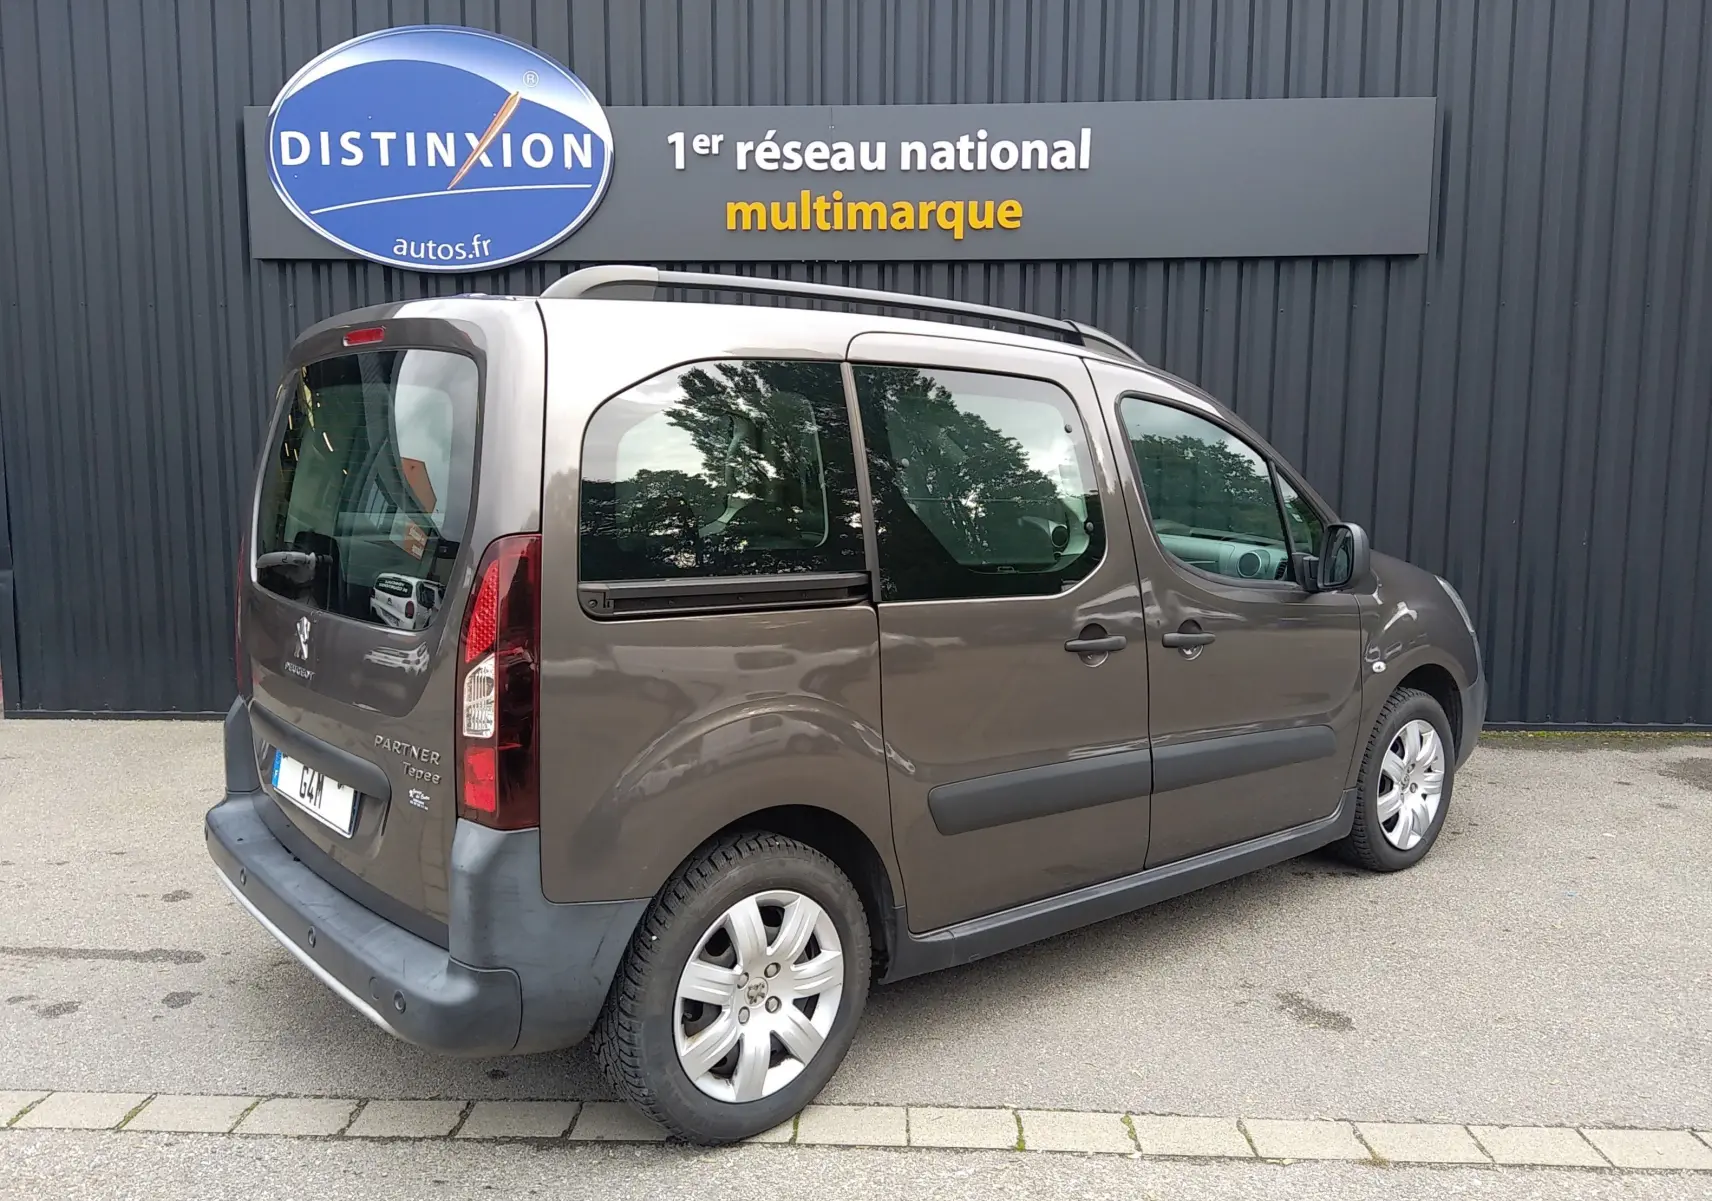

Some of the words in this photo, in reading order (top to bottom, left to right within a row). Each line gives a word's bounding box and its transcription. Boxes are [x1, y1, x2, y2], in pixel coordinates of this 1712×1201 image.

[279, 130, 593, 169] DISTINXION
[666, 130, 725, 171] 1er
[735, 129, 888, 172] réseau
[900, 127, 1092, 172] national
[725, 189, 1024, 240] multimarque
[392, 233, 493, 261] autos.fr
[374, 734, 441, 766] PARTNER
[402, 761, 442, 784] Tepee
